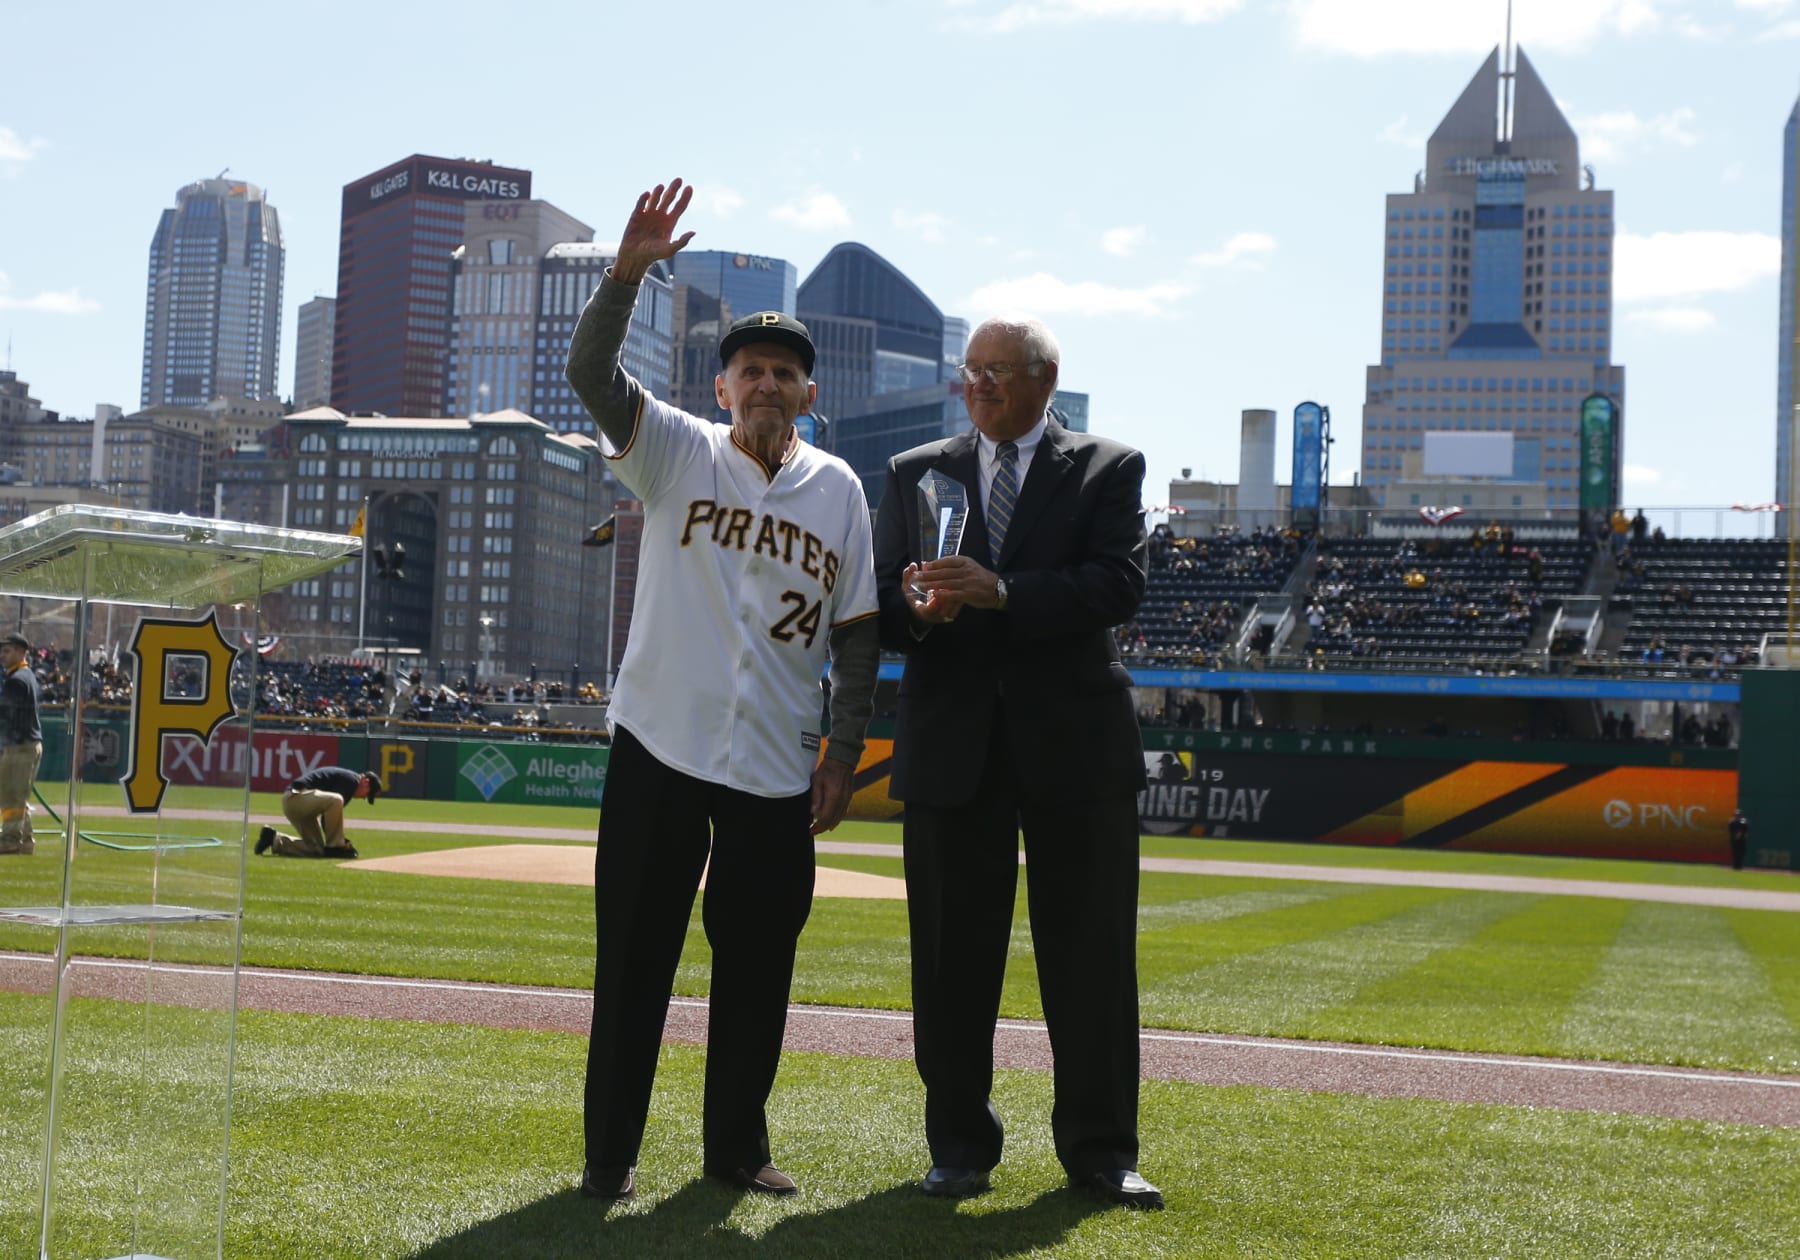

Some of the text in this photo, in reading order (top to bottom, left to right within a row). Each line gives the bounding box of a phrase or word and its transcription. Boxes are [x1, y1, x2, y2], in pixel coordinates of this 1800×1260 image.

[384, 170, 409, 196] GATES
[427, 169, 520, 198] K&L GATES
[761, 312, 780, 327] P
[680, 498, 841, 595] PIRATES
[769, 589, 823, 649] 24
[119, 605, 241, 814] P
[170, 730, 326, 782] xfinity
[1163, 734, 1377, 754] TO PNC PARK
[380, 743, 415, 792] P
[1200, 769, 1224, 782] 19
[525, 783, 569, 797] Health
[1207, 786, 1271, 822] DAY
[1638, 802, 1707, 830] PNC
